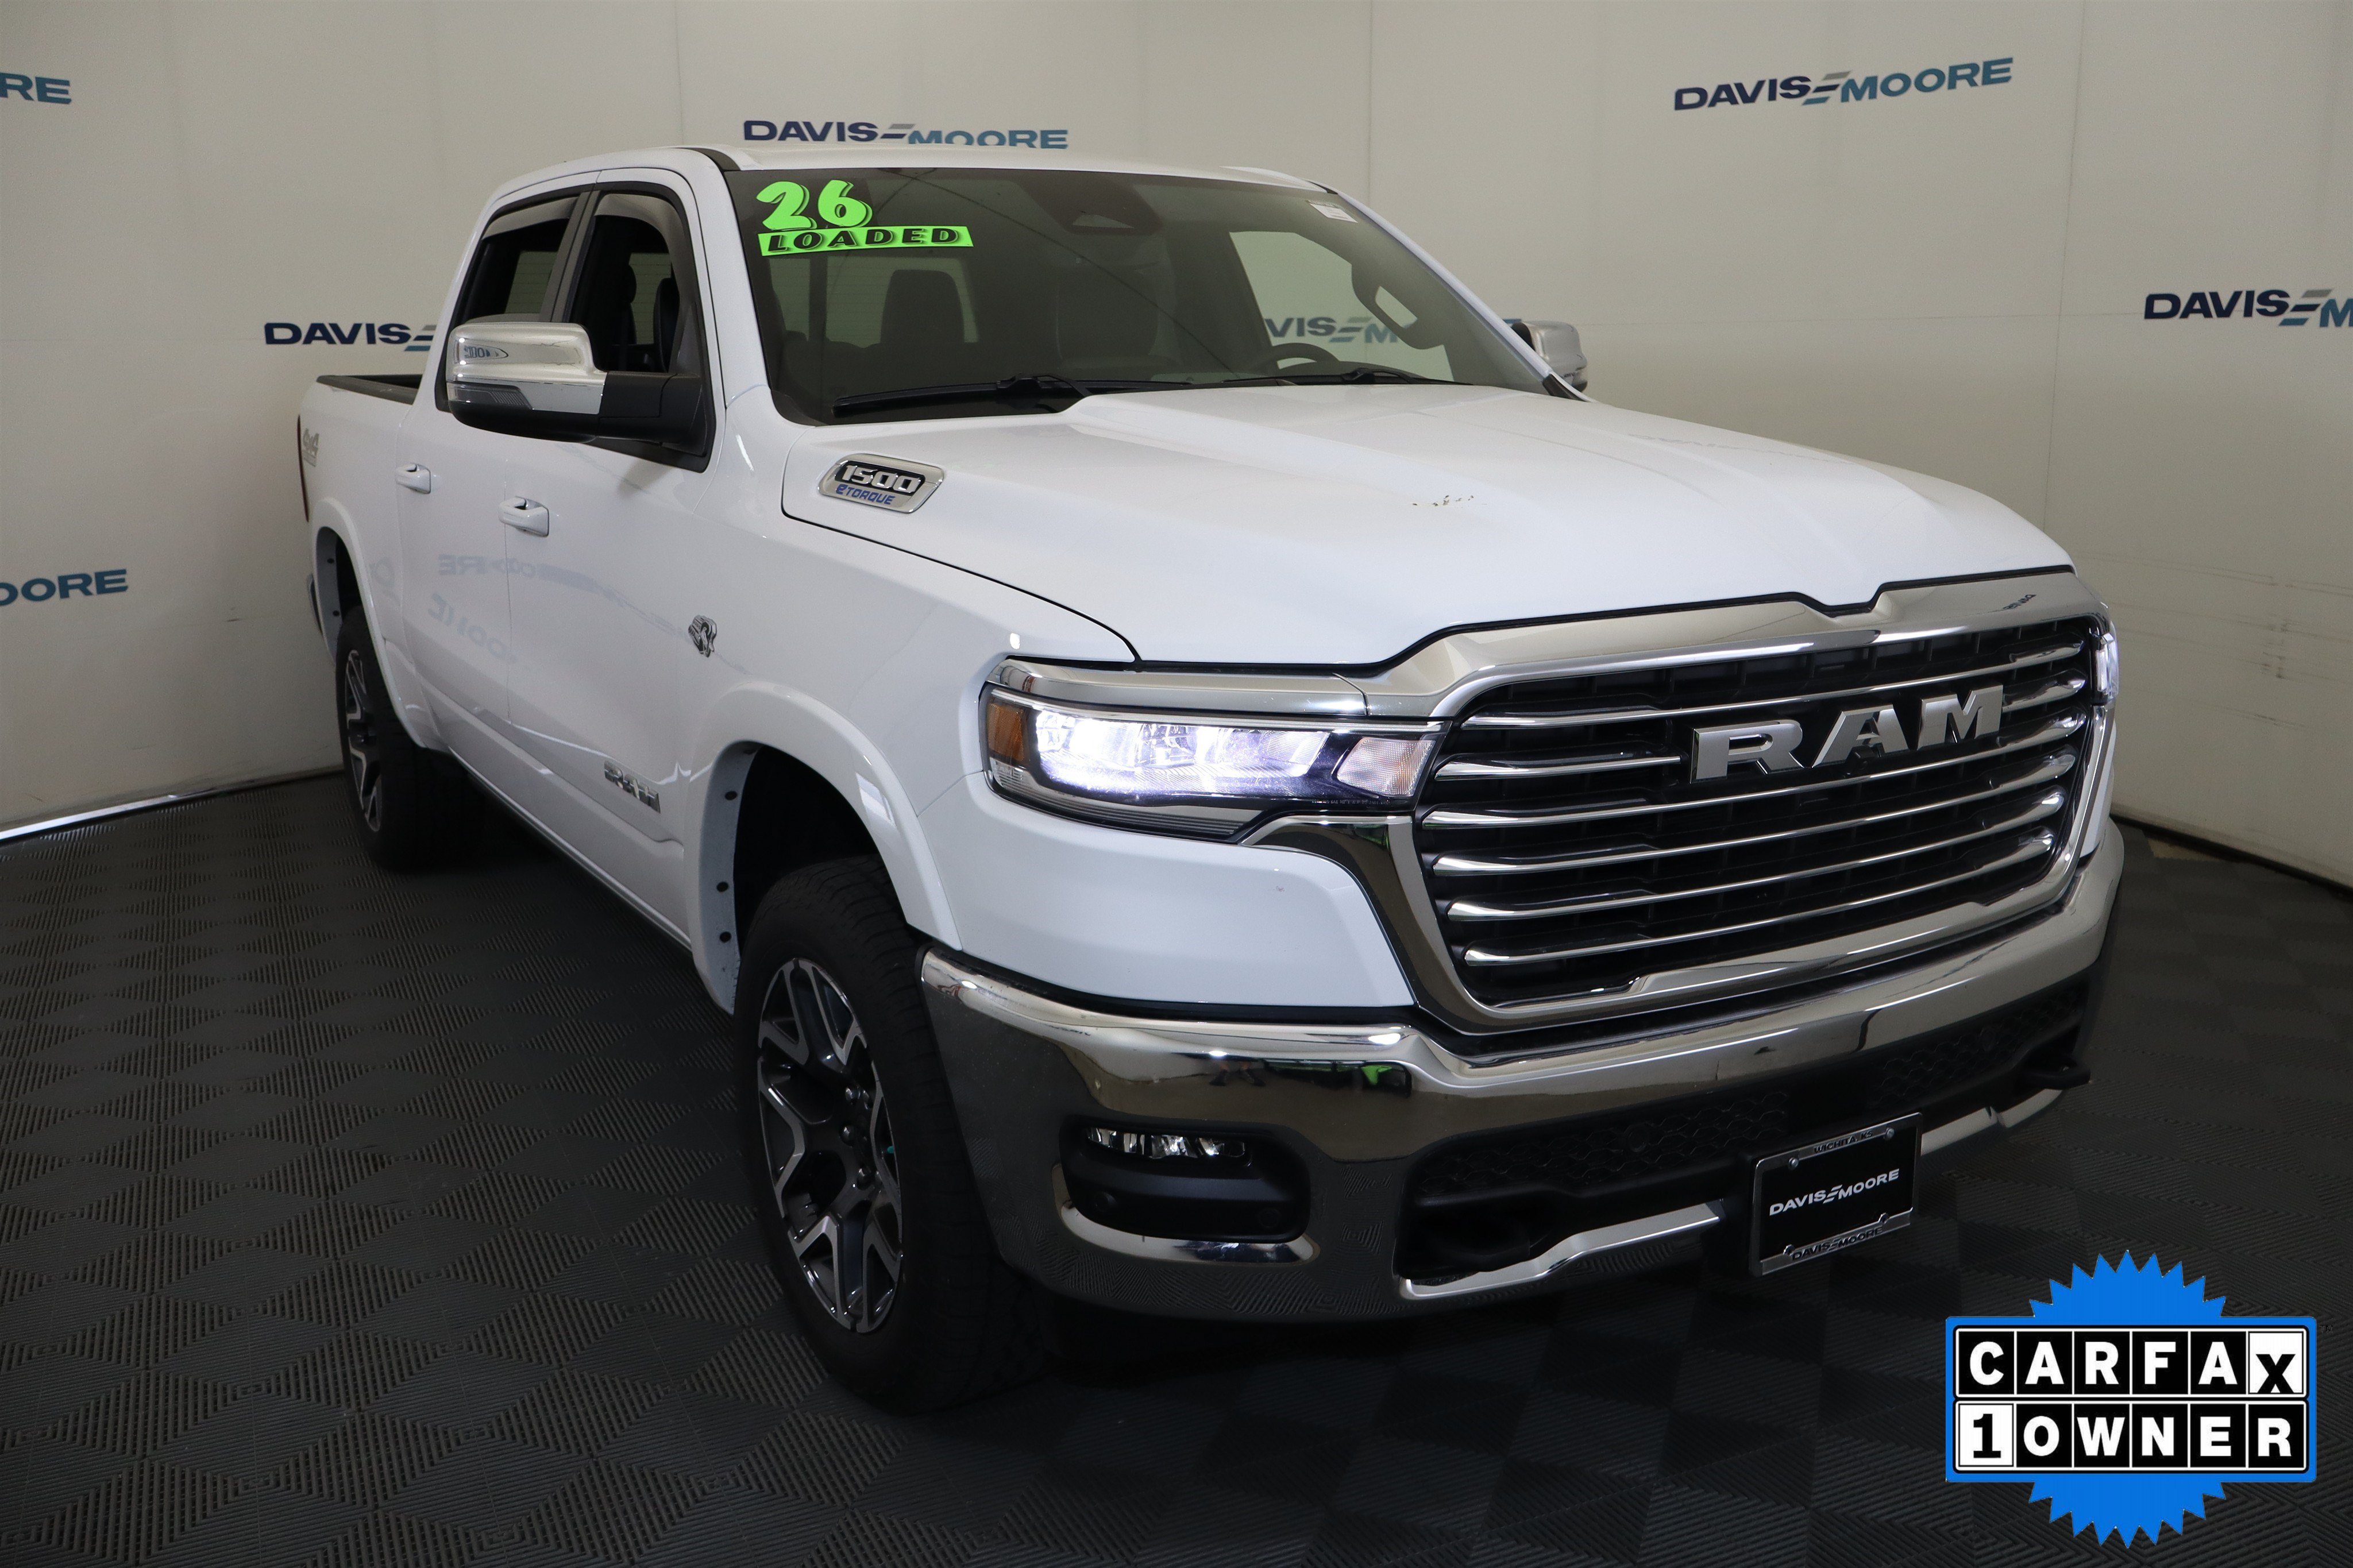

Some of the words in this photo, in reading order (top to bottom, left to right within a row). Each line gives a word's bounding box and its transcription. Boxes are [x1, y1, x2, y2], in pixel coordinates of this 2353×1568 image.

[1674, 76, 1811, 110] DAVIS
[1840, 57, 2013, 102] MOORE
[744, 121, 878, 142] DAVIS
[908, 130, 1068, 150] MOORE
[756, 179, 873, 230] 26
[767, 227, 959, 253] LOADED
[2144, 289, 2290, 319] DAVIS
[264, 323, 412, 345] DAVIS
[842, 465, 921, 493] 1500
[1689, 685, 2004, 784] RAM
[604, 760, 661, 813] RAM
[1814, 1136, 1858, 1153] WICHITA,
[1861, 1130, 1873, 1140] KS
[1769, 1189, 1827, 1216] DAVIS
[1838, 1168, 1900, 1200] MOORE
[1792, 1240, 1830, 1261] DAVIS
[1838, 1225, 1884, 1248] MOORE
